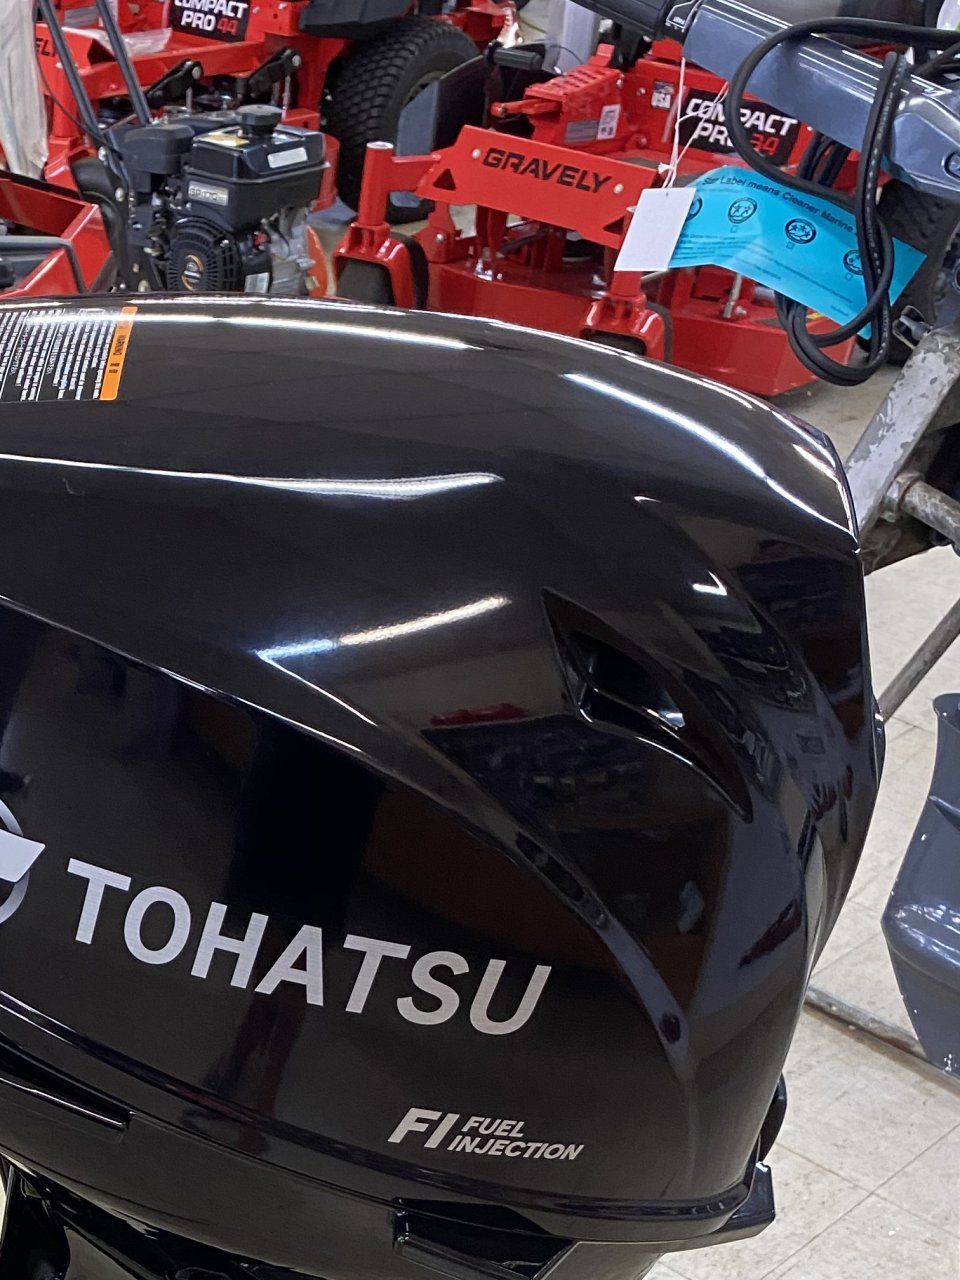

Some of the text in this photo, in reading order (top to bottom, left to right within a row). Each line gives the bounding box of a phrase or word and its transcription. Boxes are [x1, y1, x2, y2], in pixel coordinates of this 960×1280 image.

[180, 10, 238, 35] PRO 44
[481, 147, 612, 194] GRAVELY
[721, 176, 746, 186] Label
[748, 181, 780, 196] means
[782, 192, 820, 214] Cleaner
[821, 209, 854, 232] Marine
[66, 857, 552, 1036] TOHATSU
[387, 1107, 460, 1149] FI
[447, 1135, 585, 1160] INJECTION
[461, 1116, 527, 1138] FUEL
